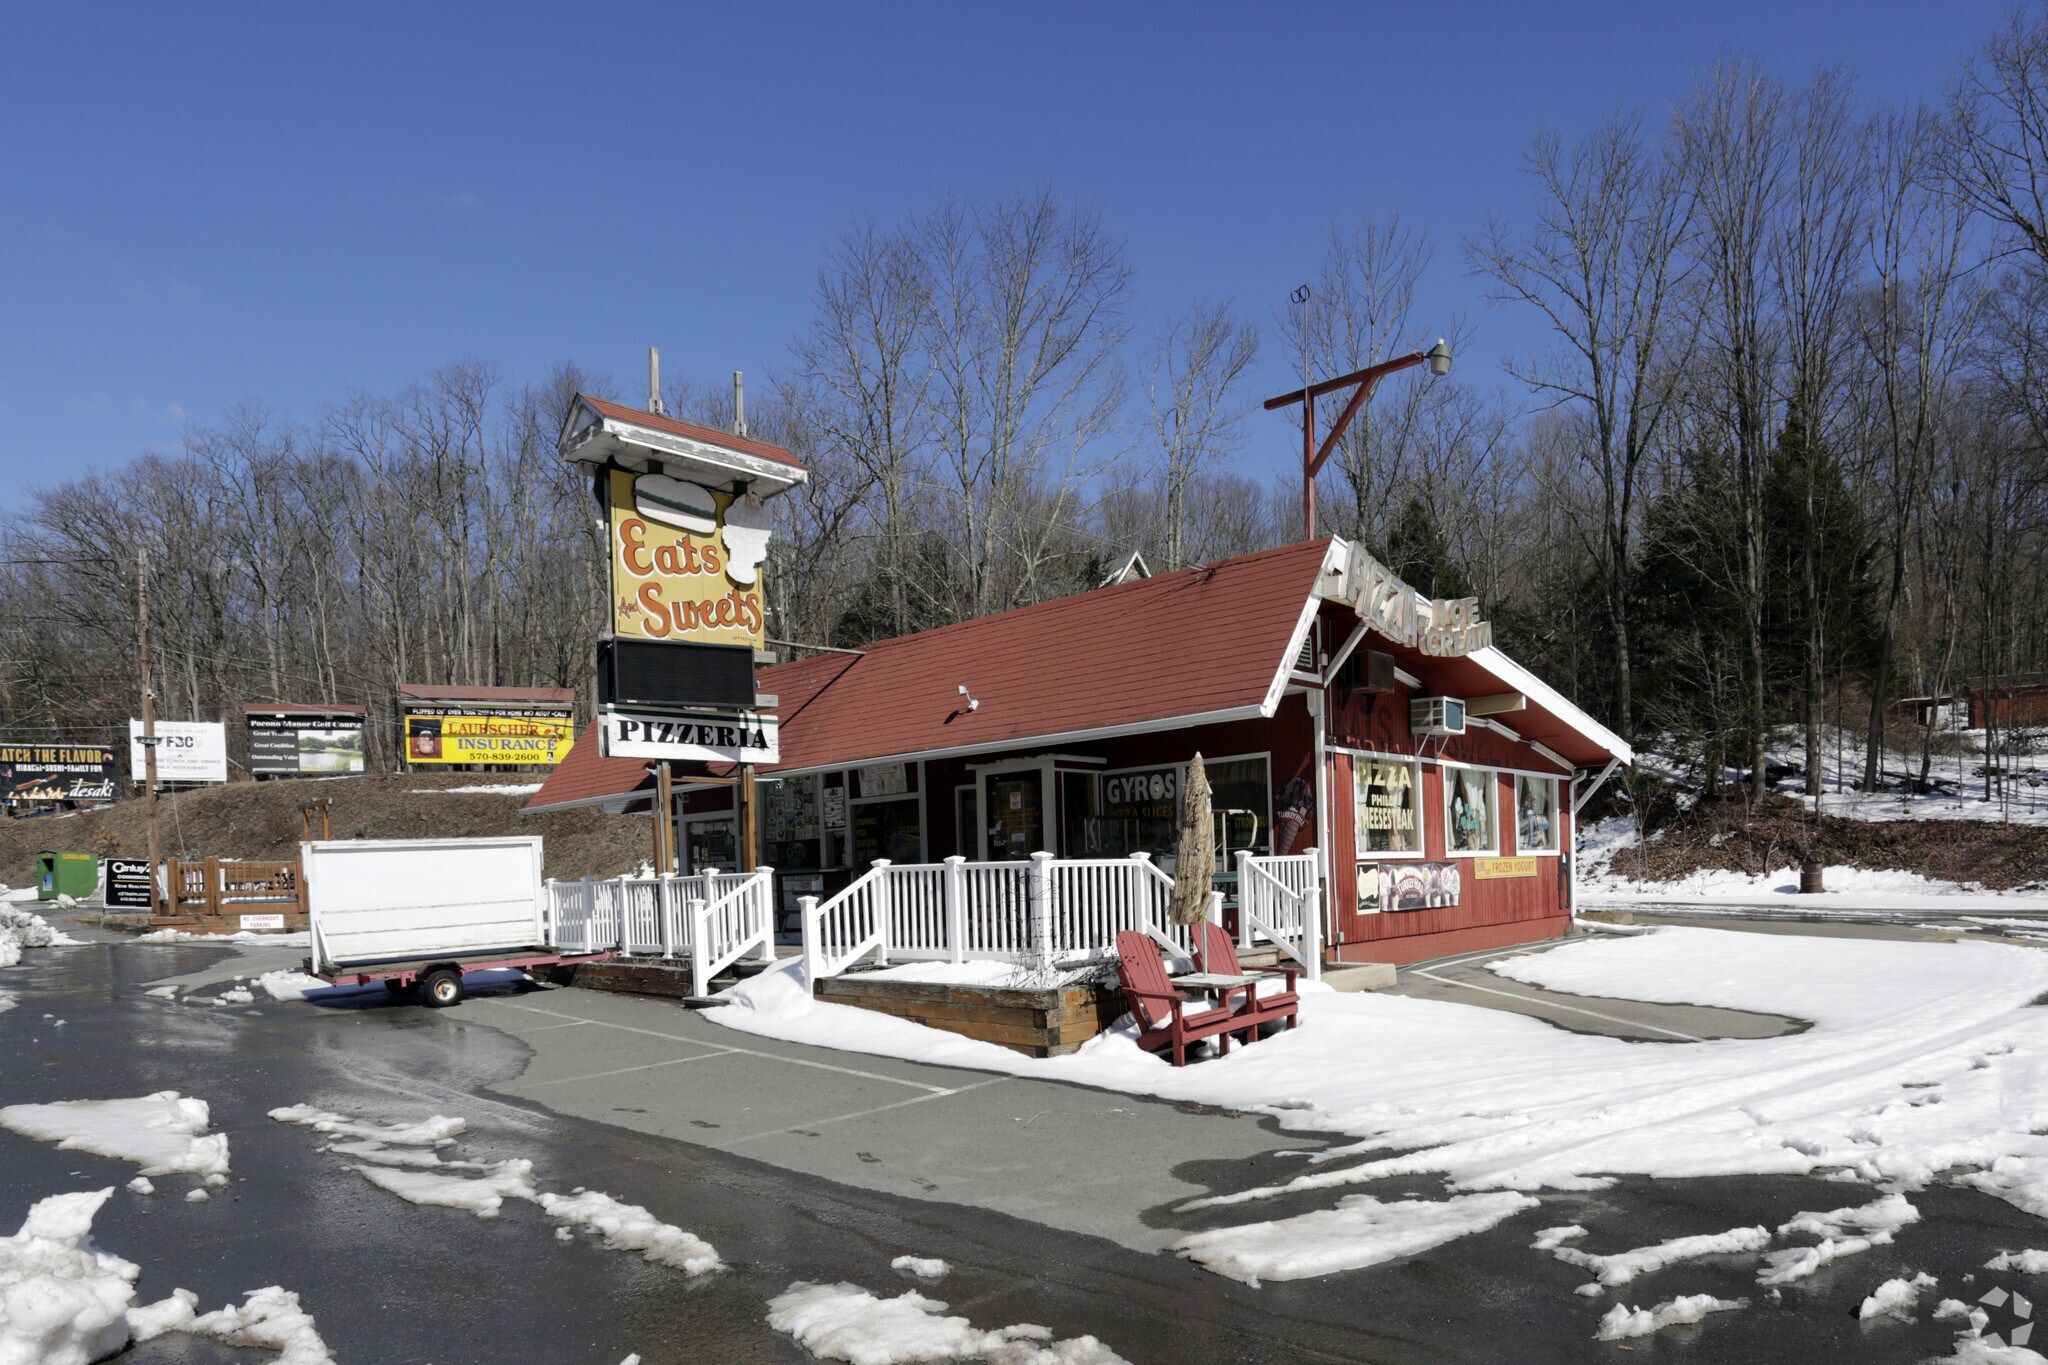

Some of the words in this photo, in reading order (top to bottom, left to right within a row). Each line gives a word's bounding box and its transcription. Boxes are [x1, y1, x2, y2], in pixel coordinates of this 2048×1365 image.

[618, 518, 721, 577] Eats
[637, 581, 763, 637] Sweets
[1339, 540, 1418, 648] PIZZA
[1432, 596, 1480, 626] ICE
[1420, 621, 1493, 657] CREAM
[457, 738, 558, 751] INSURANCE
[617, 719, 770, 749] PIZZERIA
[34, 749, 57, 763] THE
[60, 750, 103, 764] FLAVOR
[469, 752, 540, 761] 570-839-2600
[69, 778, 115, 797] desaki
[1107, 772, 1175, 804] GYROS
[1357, 762, 1412, 788] PIZZA
[1492, 861, 1513, 873] FROZEN
[1513, 860, 1535, 872] YOGURT
